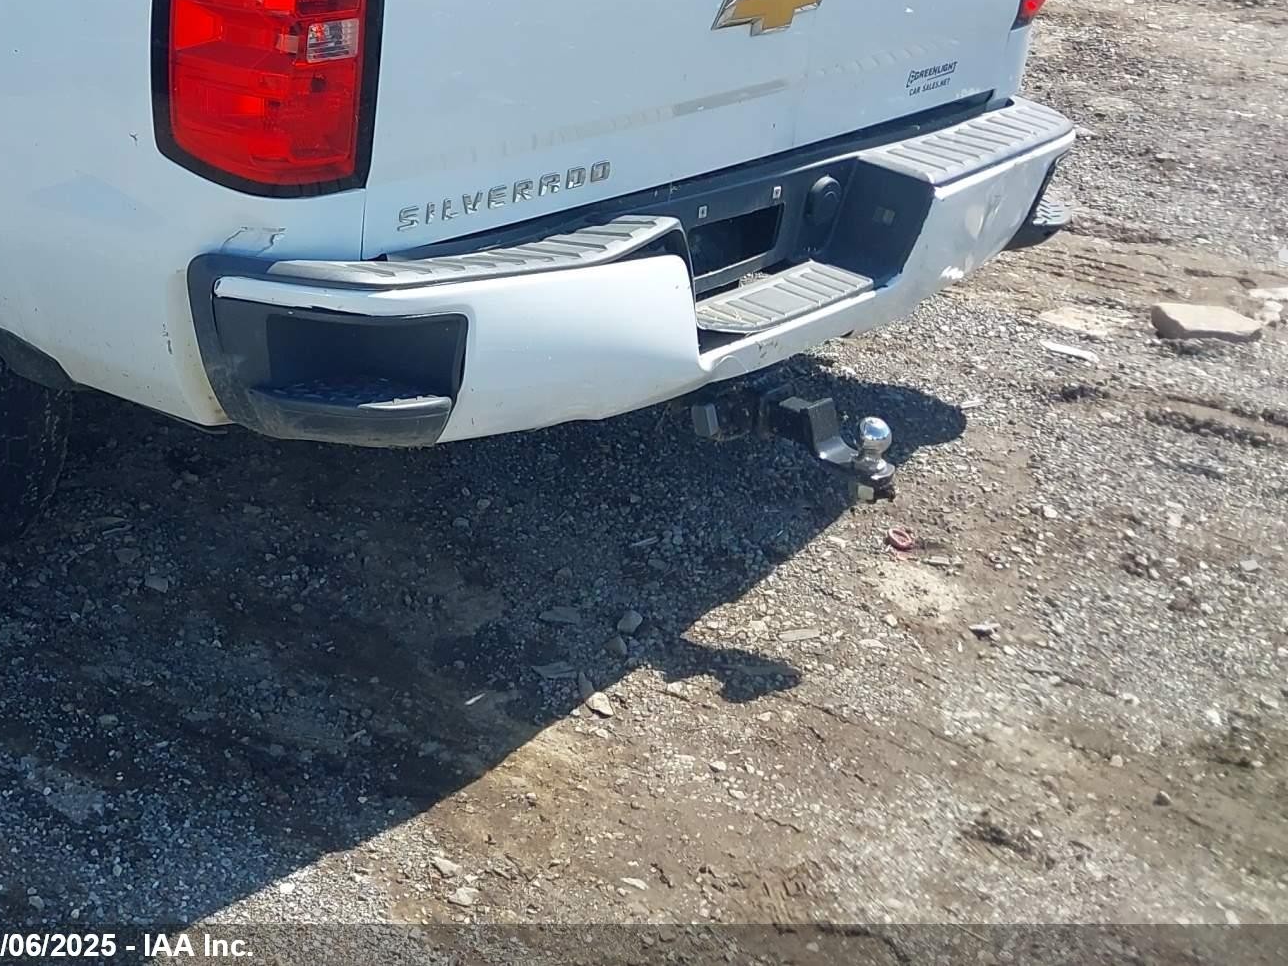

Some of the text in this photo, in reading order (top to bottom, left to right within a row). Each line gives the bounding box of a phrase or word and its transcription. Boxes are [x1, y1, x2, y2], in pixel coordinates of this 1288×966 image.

[913, 60, 958, 81] GREENLIGHT
[909, 85, 921, 96] CAR
[396, 160, 611, 232] SILVERADO
